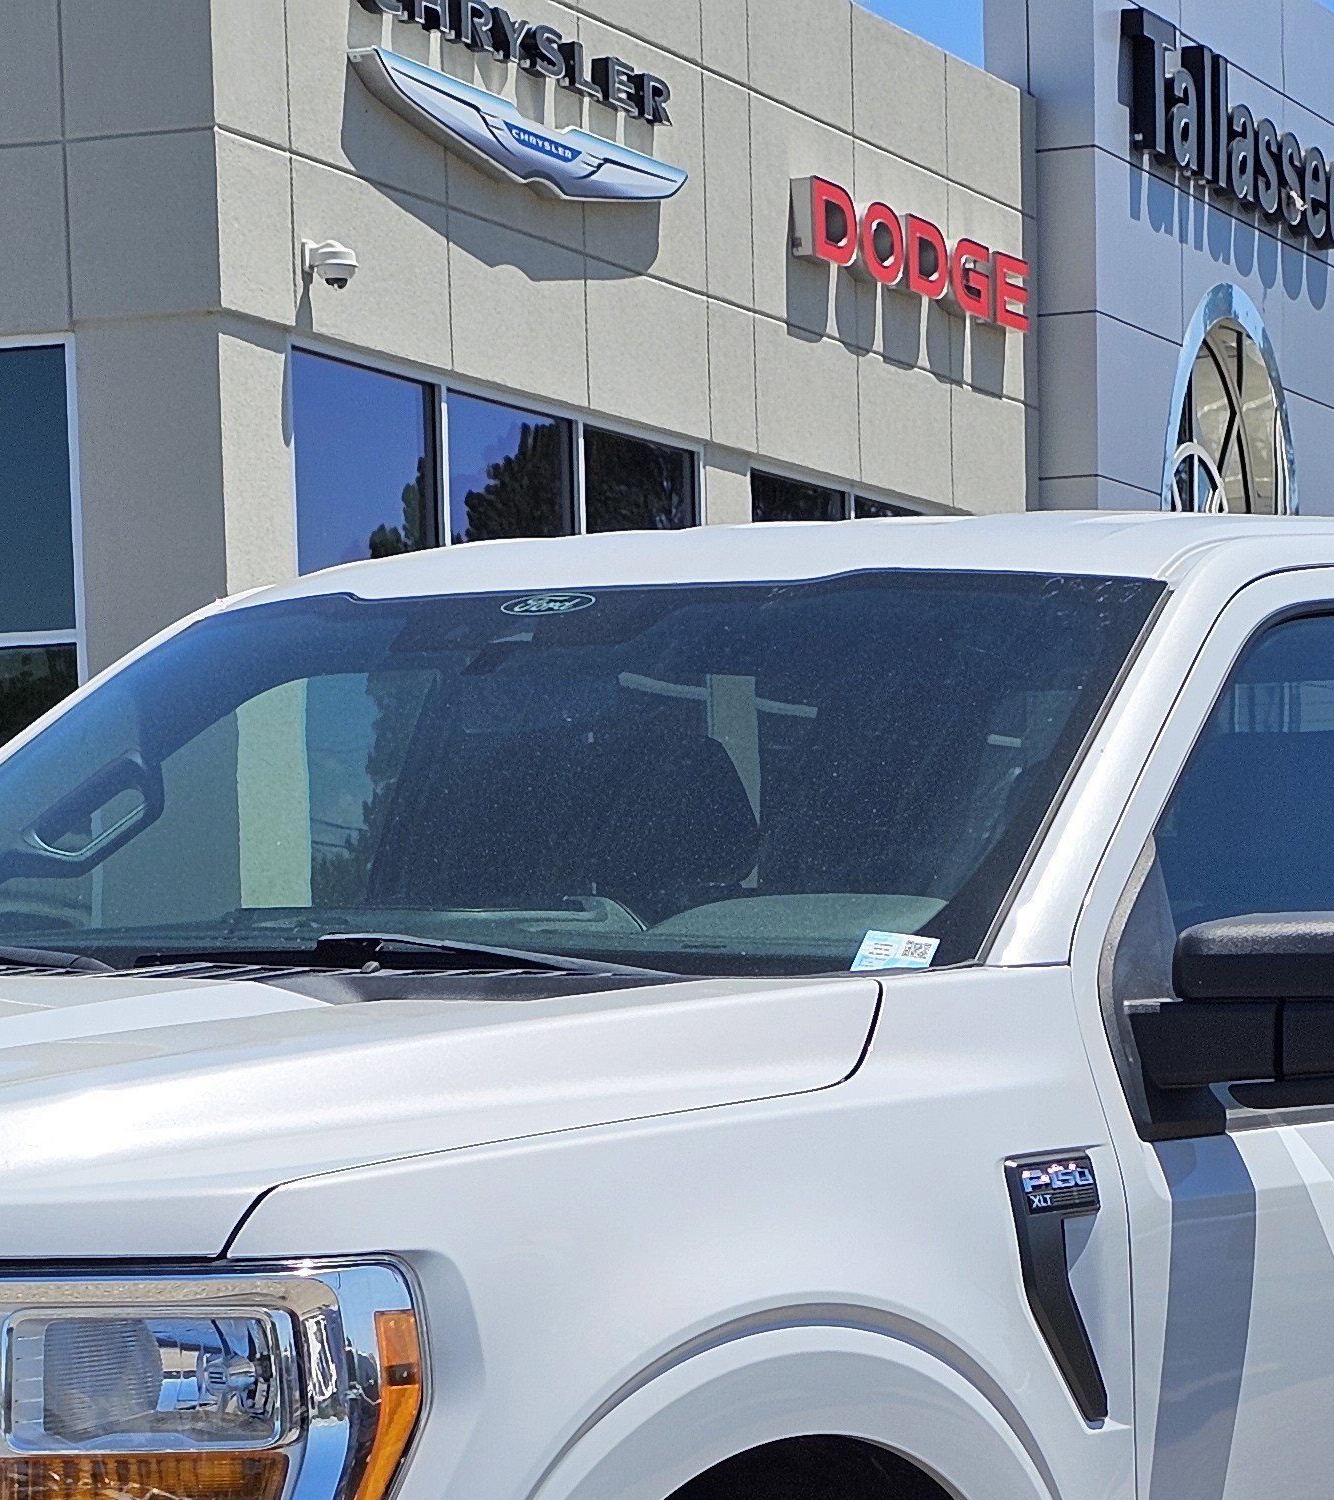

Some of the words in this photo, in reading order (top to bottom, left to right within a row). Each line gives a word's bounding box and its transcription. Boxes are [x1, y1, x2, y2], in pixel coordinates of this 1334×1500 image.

[359, 0, 672, 126] HRYSLER
[512, 129, 572, 158] CHRYSLER
[809, 175, 1029, 332] DODGE
[514, 595, 582, 612] Ford
[1029, 1194, 1052, 1209] XLT
